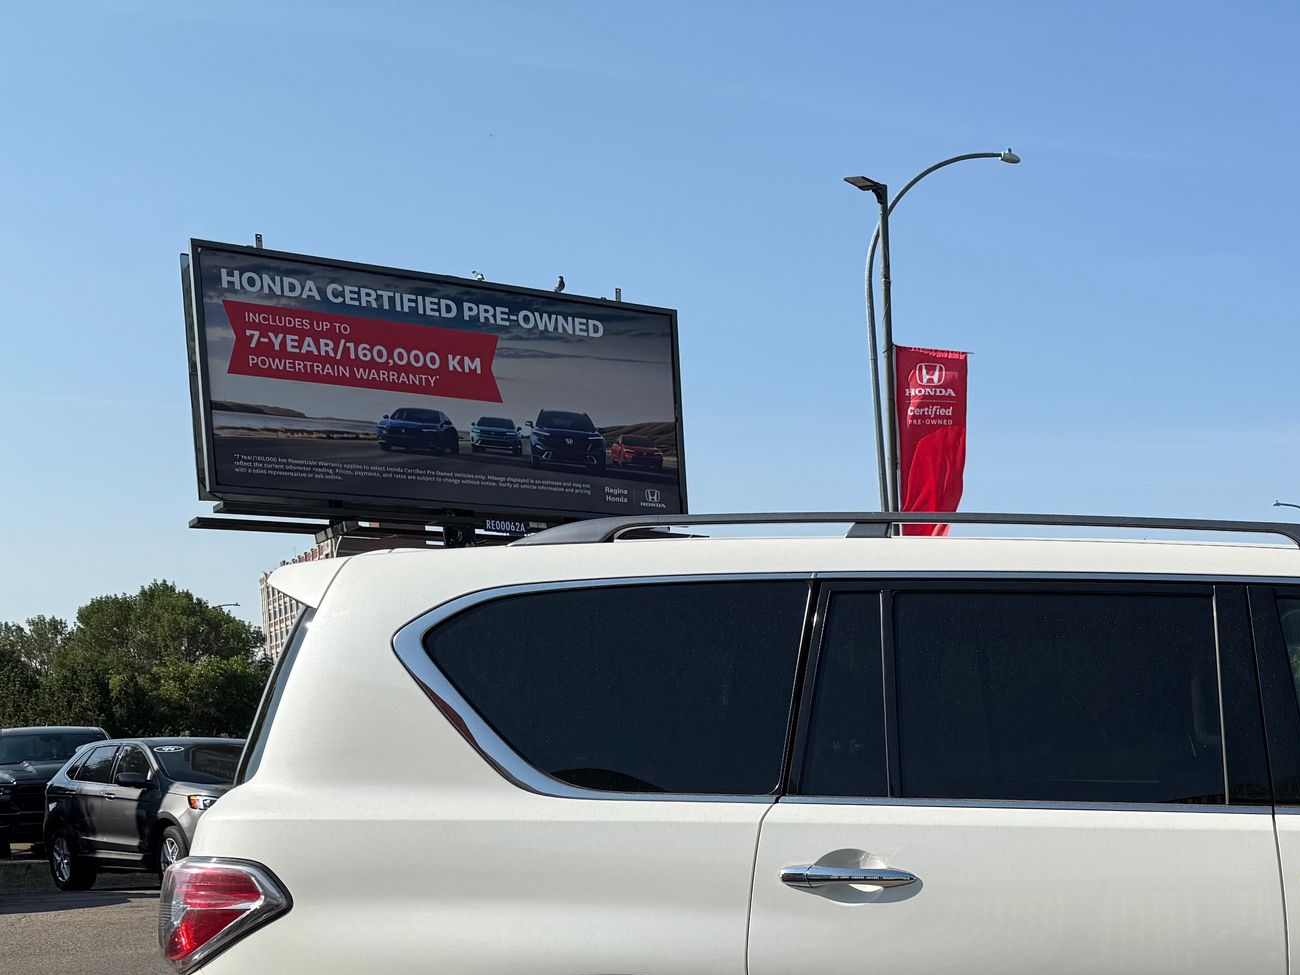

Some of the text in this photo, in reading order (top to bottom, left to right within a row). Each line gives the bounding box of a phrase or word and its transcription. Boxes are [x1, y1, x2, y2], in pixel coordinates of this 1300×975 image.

[220, 268, 604, 338] HONDA CERTIFIED PRE-OWNED
[245, 311, 350, 335] INCLUDES UP TO
[245, 329, 482, 375] 7-YEAR/160,000 KM
[249, 355, 350, 378] POWERTRAIN
[905, 387, 956, 397] HONDA
[907, 405, 953, 417] Certified
[604, 486, 628, 495] Regina
[605, 495, 628, 503] Honda
[486, 519, 526, 532] RE00062A
